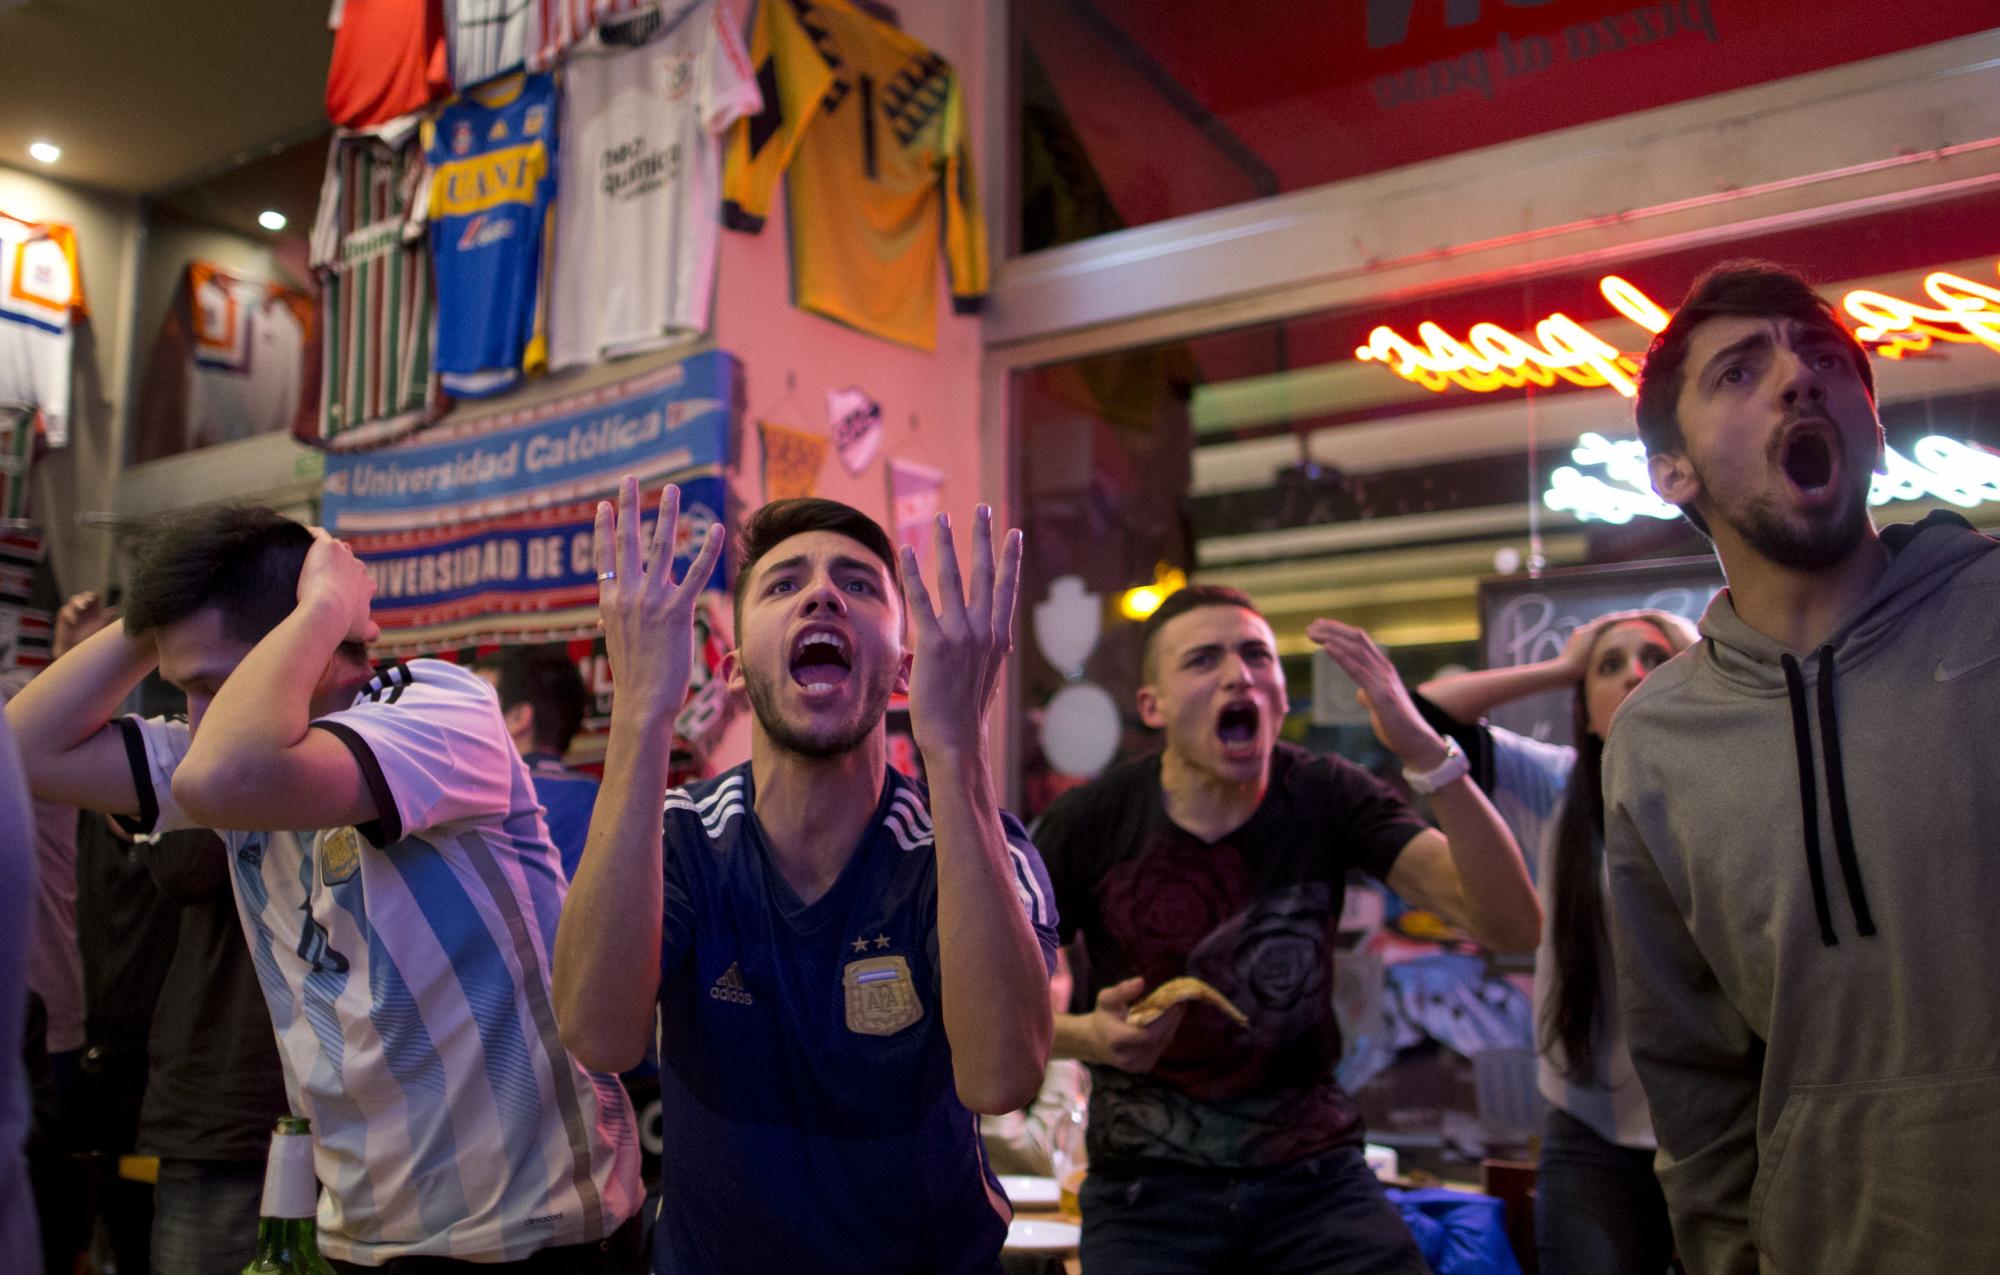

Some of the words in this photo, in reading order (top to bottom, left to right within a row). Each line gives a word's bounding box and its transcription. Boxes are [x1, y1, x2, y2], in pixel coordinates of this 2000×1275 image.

[352, 443, 519, 496] Universidad
[525, 412, 660, 471] Católica
[367, 538, 521, 599] NIVERSIDAD
[527, 535, 563, 580] DE
[709, 985, 754, 1007] adidas
[867, 988, 900, 1012] AFA
